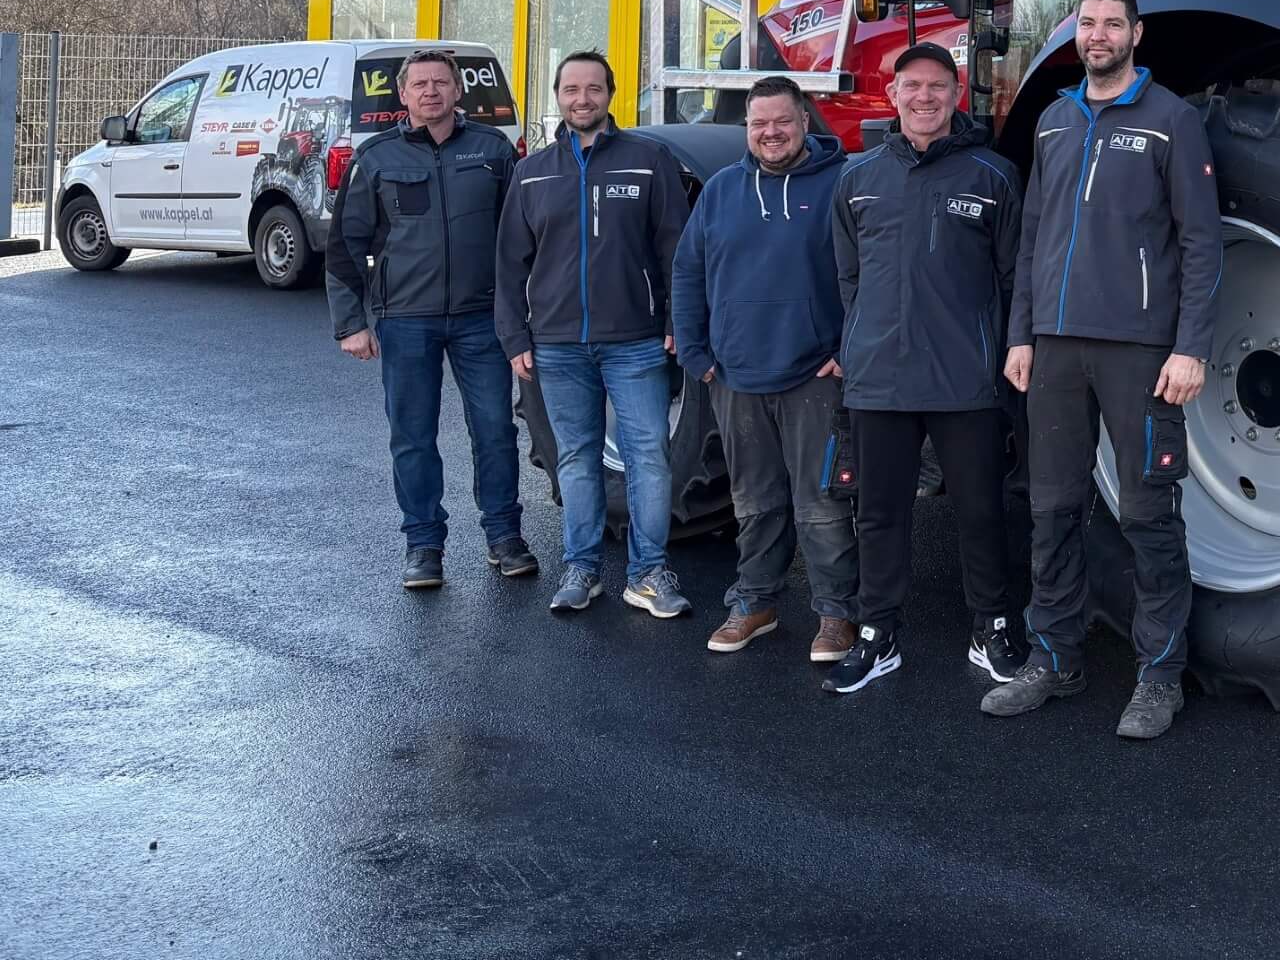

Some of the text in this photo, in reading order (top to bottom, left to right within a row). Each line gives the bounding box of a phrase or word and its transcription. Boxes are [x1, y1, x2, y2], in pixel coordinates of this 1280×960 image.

[790, 7, 825, 35] 150
[241, 56, 330, 99] Kappel
[461, 62, 498, 93] pel
[200, 122, 229, 133] STEYR
[1110, 134, 1146, 150] ATG
[607, 185, 639, 196] ATG
[139, 207, 213, 223] www.kappel.at
[948, 199, 983, 216] ATG
